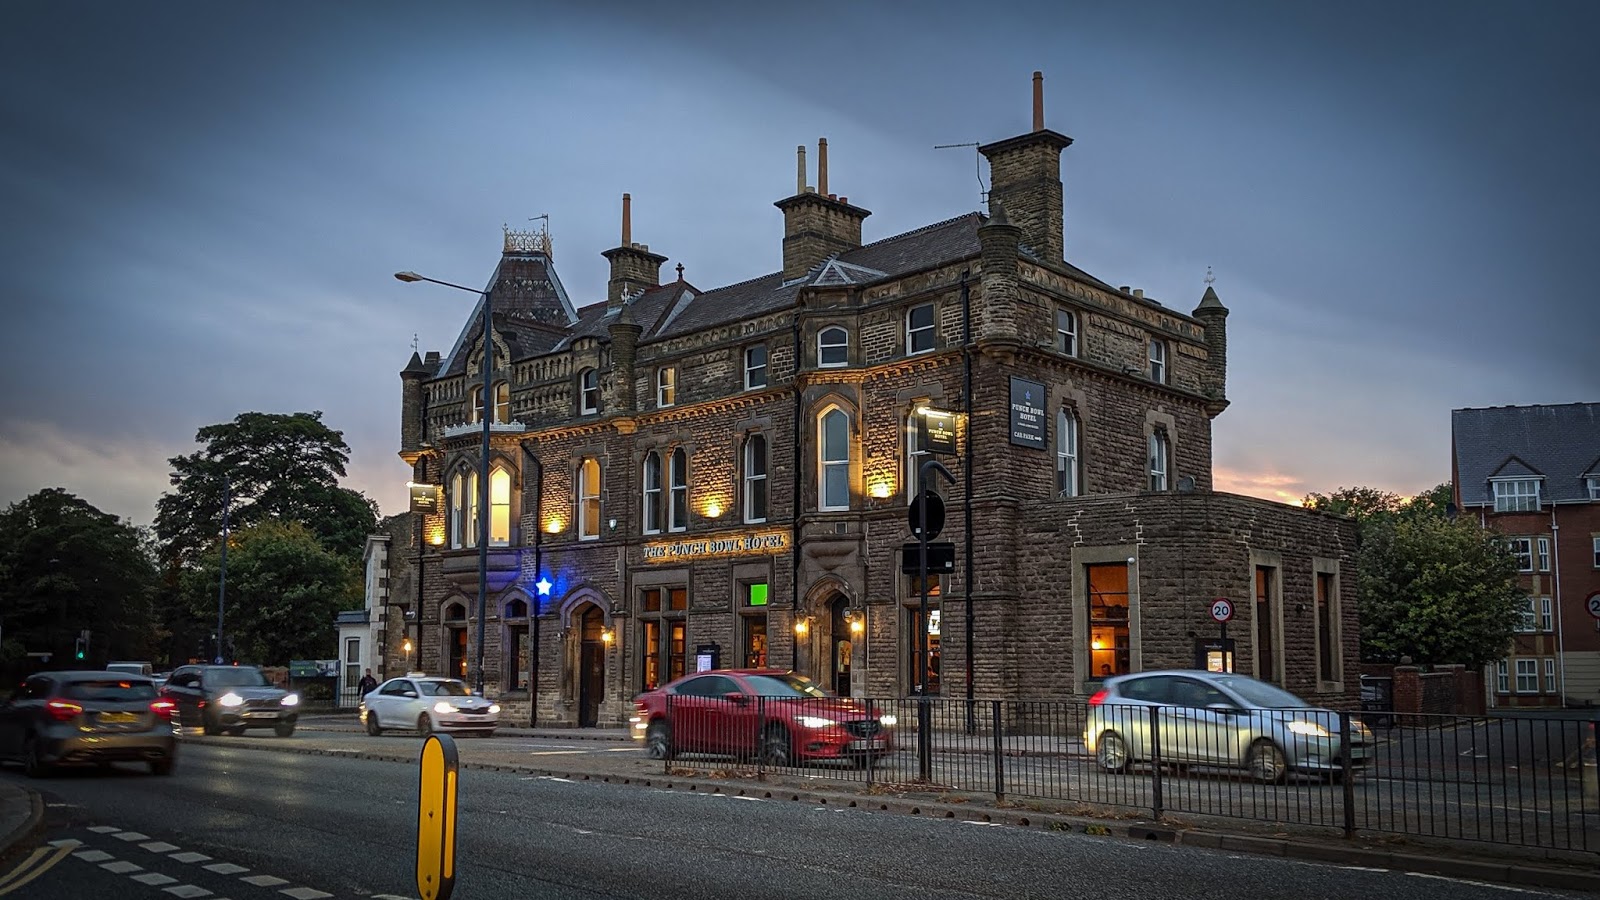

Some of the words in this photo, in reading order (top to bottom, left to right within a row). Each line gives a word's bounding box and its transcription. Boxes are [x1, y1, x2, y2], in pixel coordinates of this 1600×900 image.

[1012, 403, 1029, 413] PUNCH
[1030, 407, 1044, 416] BOWL
[1020, 413, 1037, 422] HOTEL
[643, 546, 664, 558] THE
[668, 541, 706, 556] PUNCH
[709, 540, 740, 553] BOWL
[744, 535, 784, 550] HOTEL
[1214, 606, 1229, 615] 20
